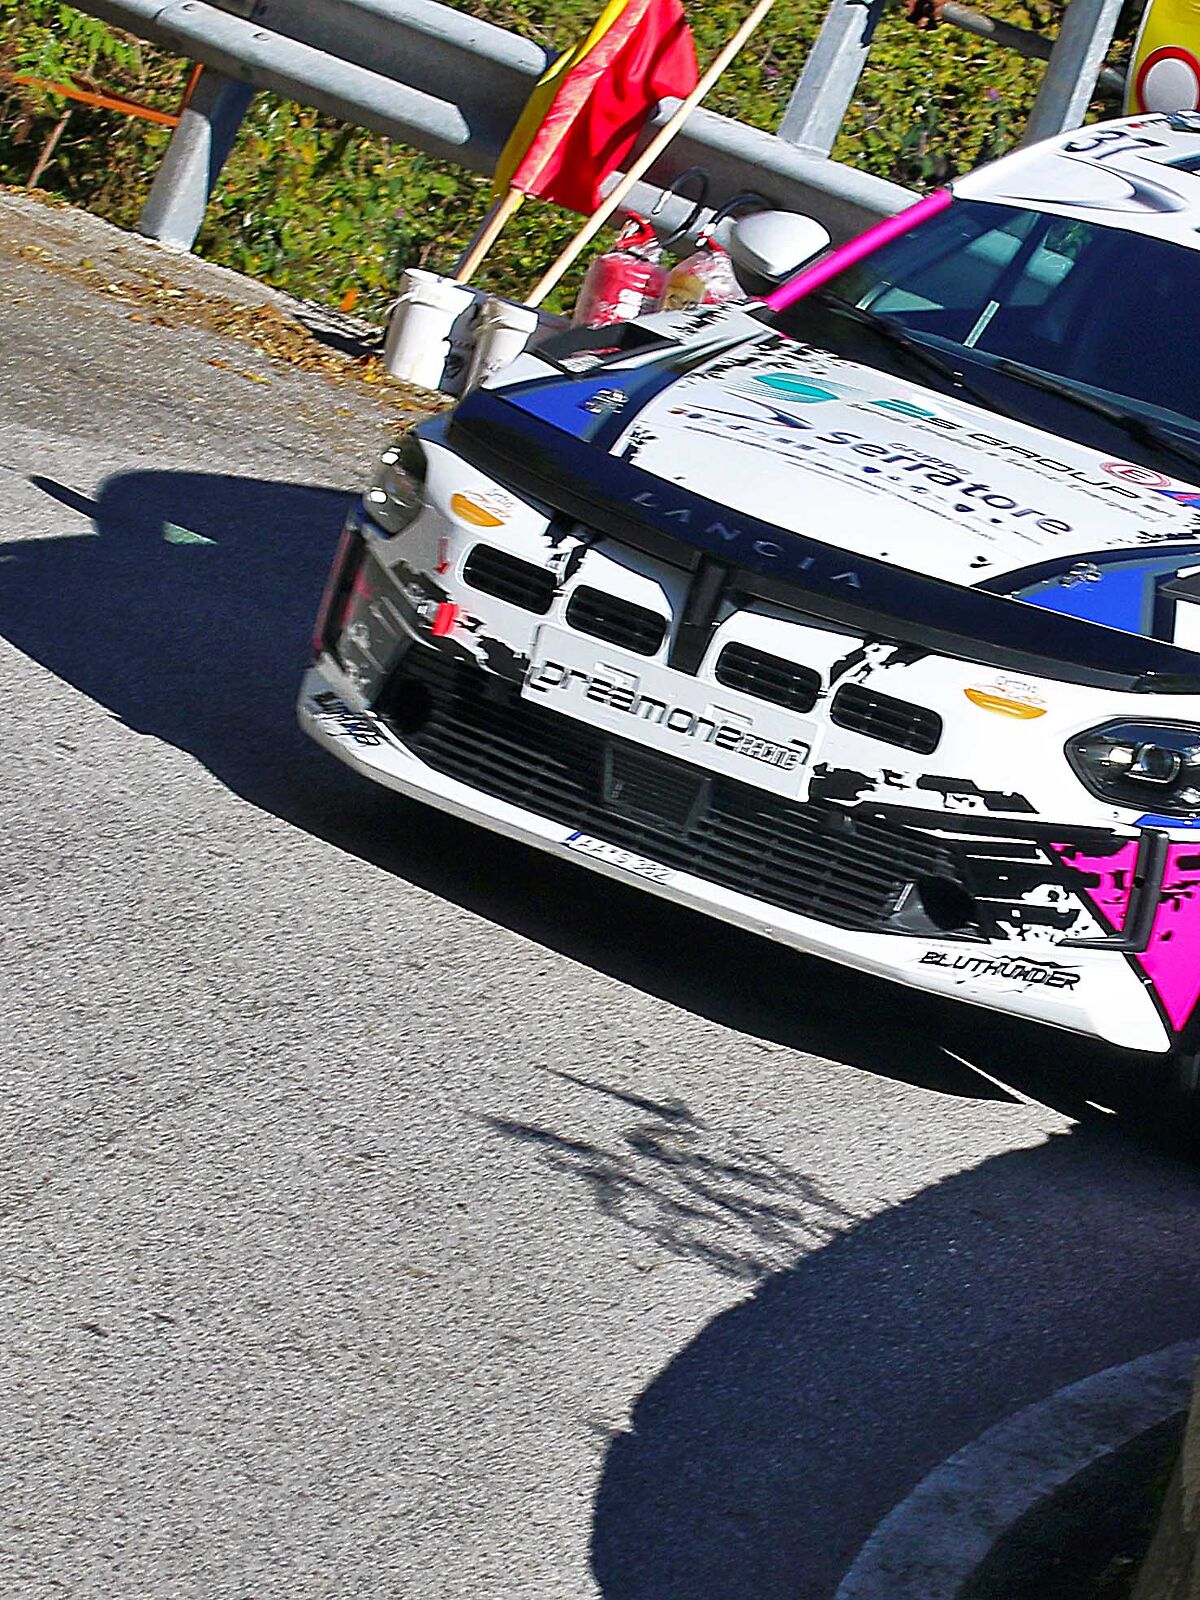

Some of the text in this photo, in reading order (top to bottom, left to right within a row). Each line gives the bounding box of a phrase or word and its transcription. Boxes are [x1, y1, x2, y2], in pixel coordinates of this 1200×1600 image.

[1061, 129, 1168, 160] 37
[888, 441, 974, 477] Gruppo
[966, 431, 1143, 500] GROUP
[632, 492, 862, 589] LANCIA
